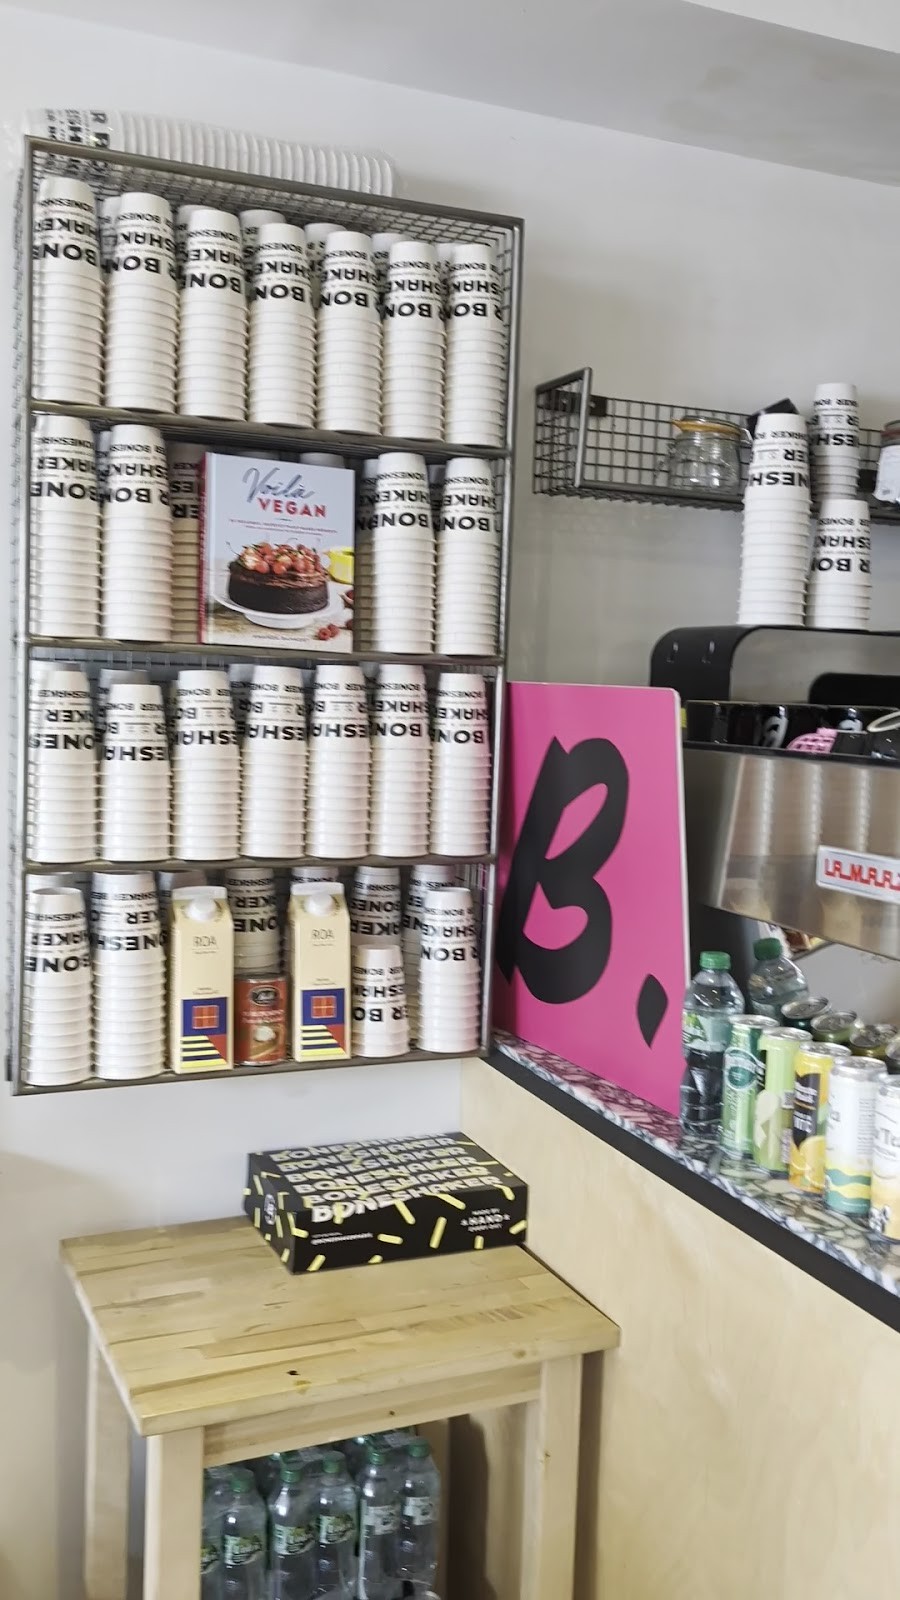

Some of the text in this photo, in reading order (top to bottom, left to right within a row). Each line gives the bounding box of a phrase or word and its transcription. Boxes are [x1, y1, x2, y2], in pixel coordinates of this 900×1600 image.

[242, 467, 315, 503] Voilà
[258, 497, 327, 518] VEGAN
[284, 1146, 468, 1184] BONESHAKER
[293, 1156, 477, 1194] BONESHAKER
[311, 1175, 503, 1223] BONESHAKER
